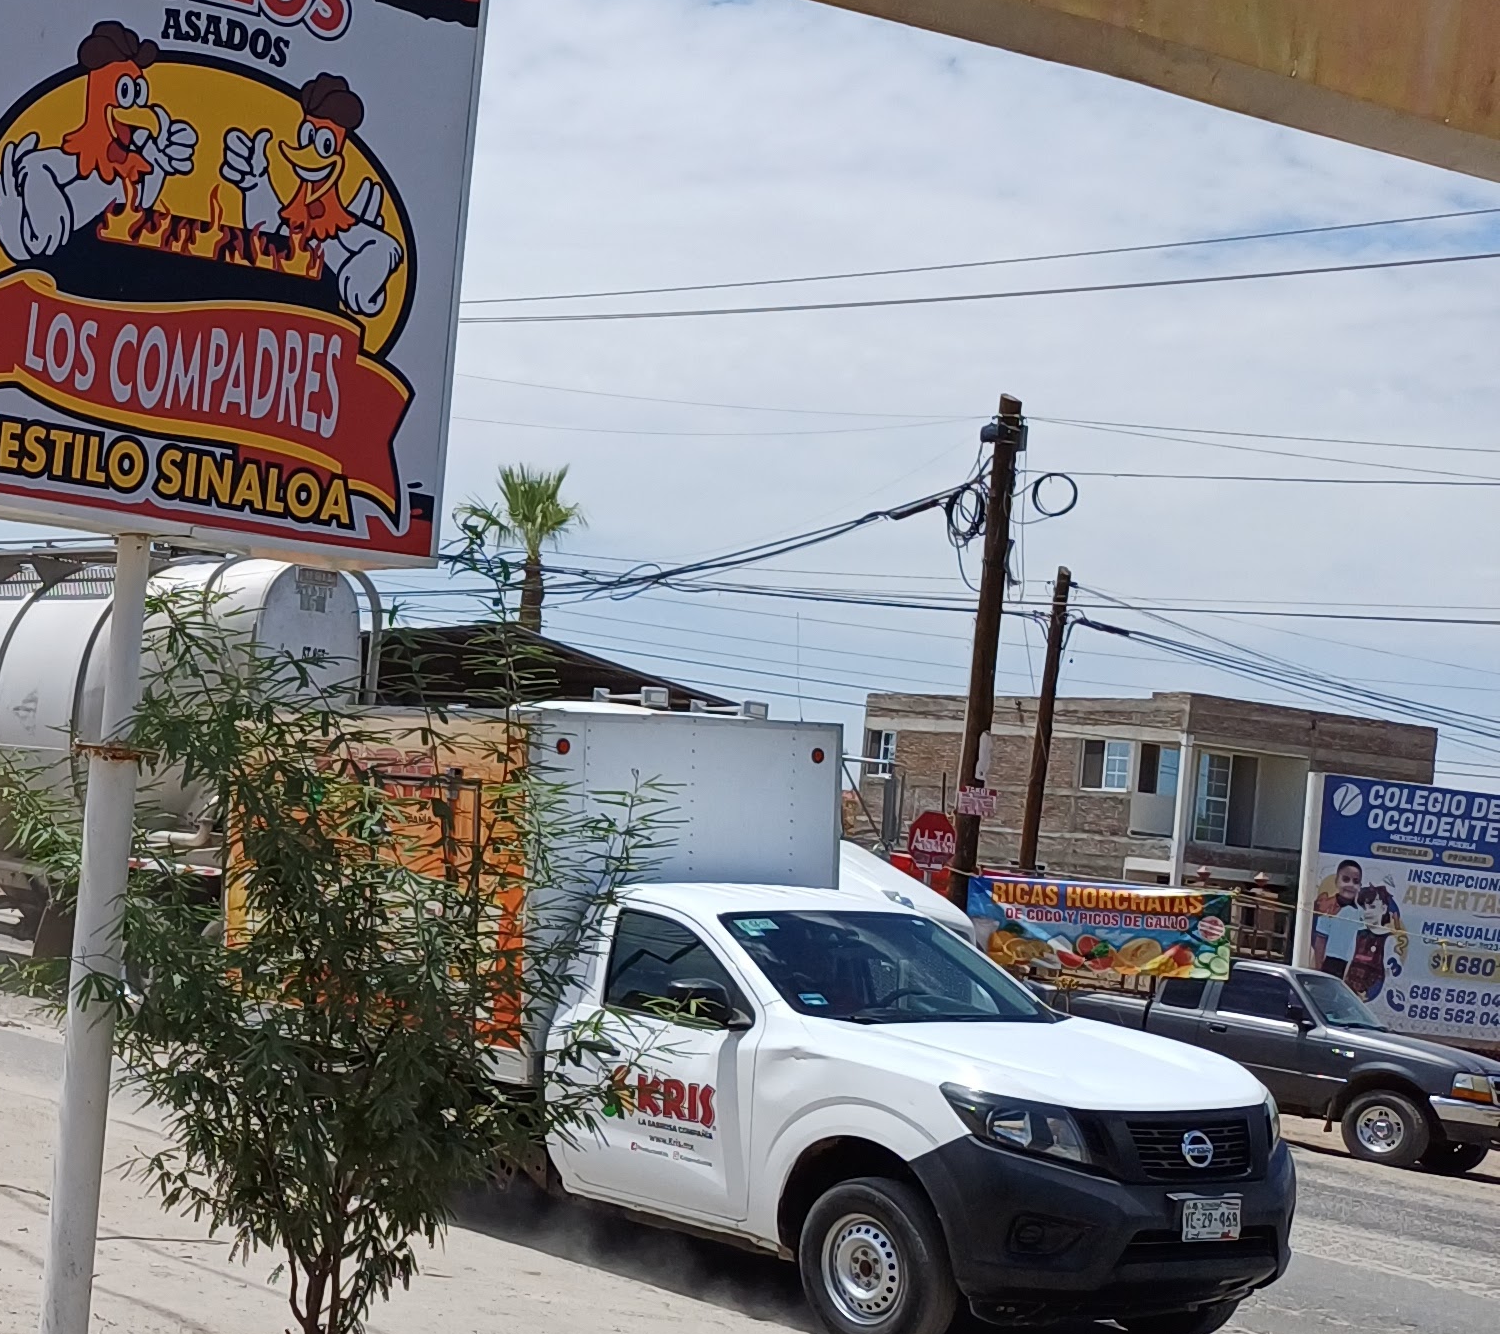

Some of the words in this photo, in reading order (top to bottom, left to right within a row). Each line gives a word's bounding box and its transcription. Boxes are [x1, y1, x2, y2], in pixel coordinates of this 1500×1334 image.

[161, 8, 290, 67] ASADOS
[24, 301, 98, 392] LOS
[110, 323, 342, 439] COMPADRES
[158, 448, 351, 524] SINALOA
[1369, 785, 1467, 816] COLEGIO
[1471, 797, 1500, 820] DE
[1367, 808, 1500, 843] OCCIDENTE
[992, 881, 1059, 907] RICAS
[1066, 885, 1204, 915] HORCHATAS
[1407, 869, 1500, 892] INSCRIPCION
[1005, 907, 1022, 920] DE
[1026, 909, 1063, 923] COCO
[1066, 910, 1075, 925] Y
[1078, 911, 1119, 927] PICOS
[1123, 914, 1140, 928] DE
[1145, 915, 1190, 931] GALLO
[1407, 1004, 1440, 1021] 686
[1443, 1008, 1476, 1025] 562
[638, 1073, 716, 1129] KRIS
